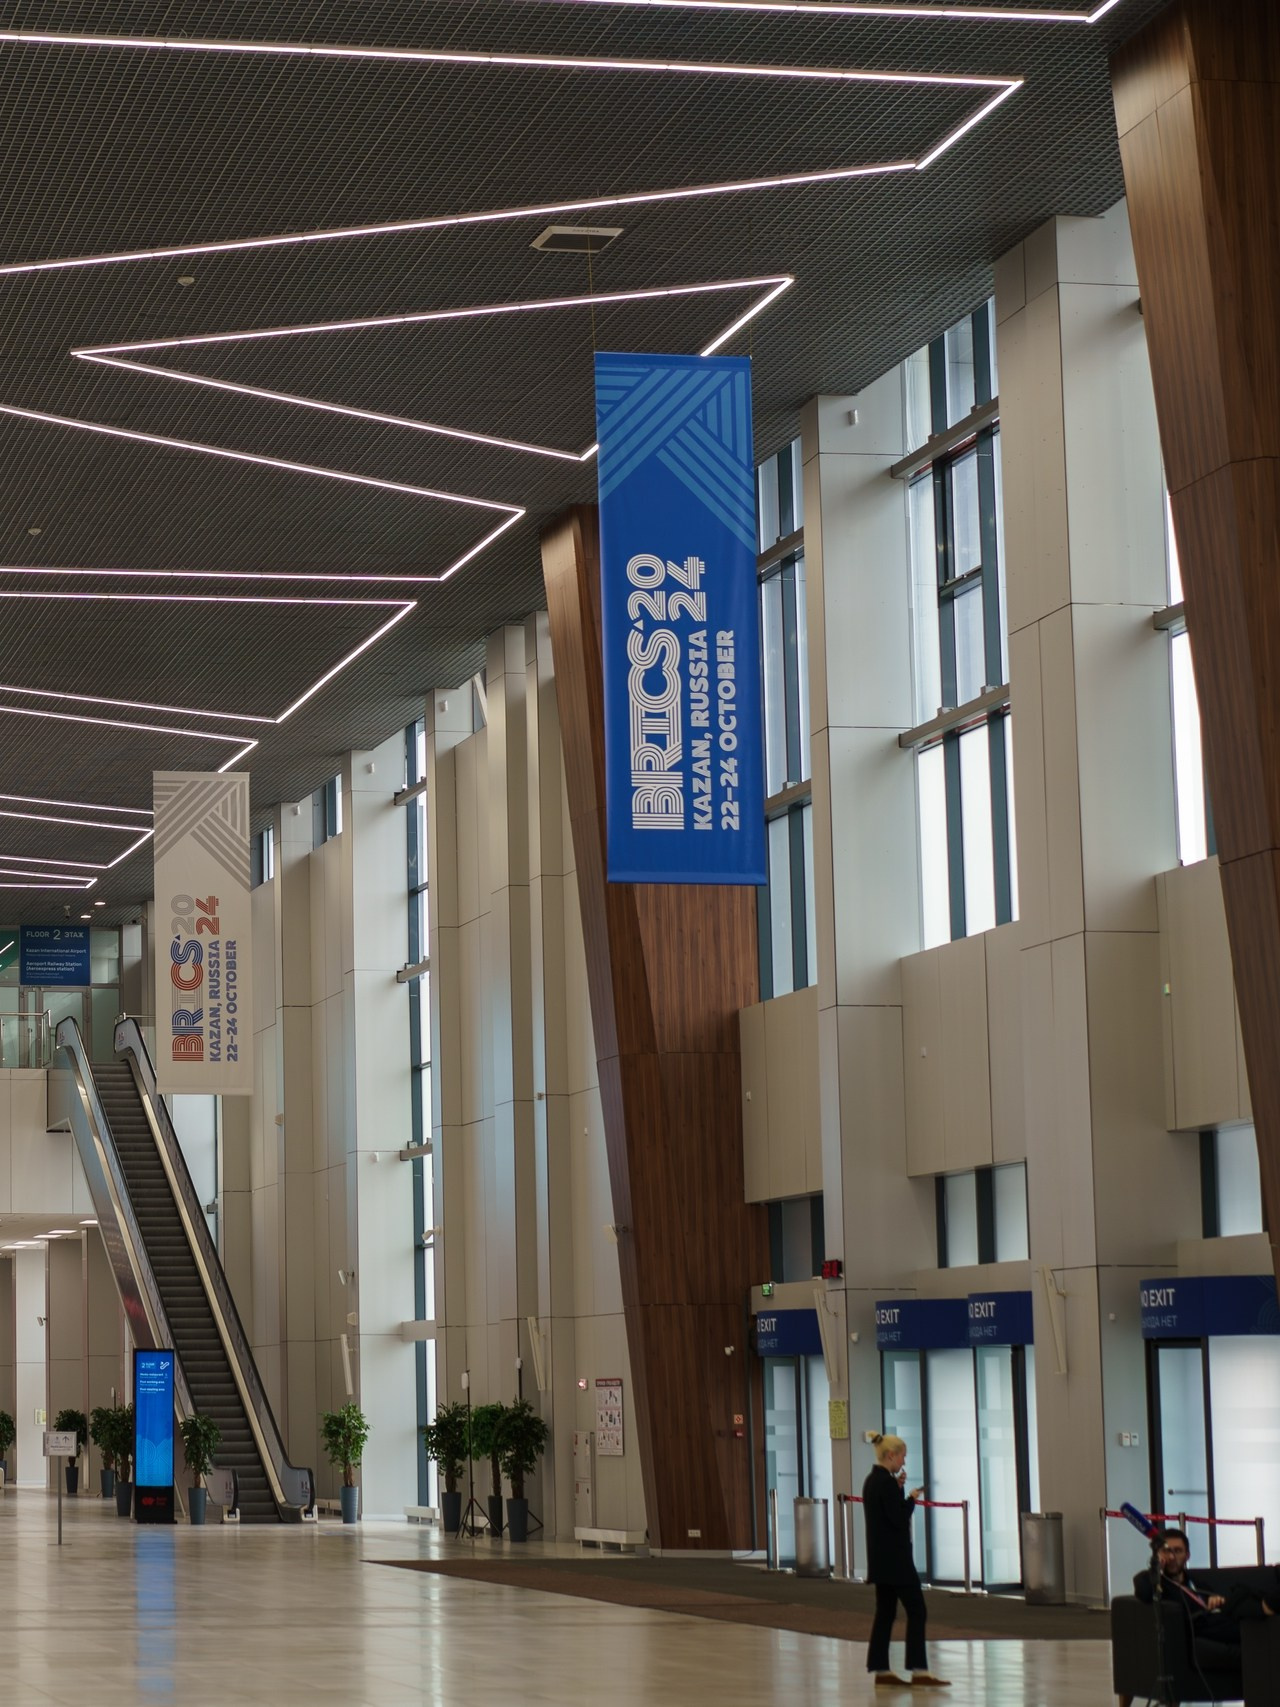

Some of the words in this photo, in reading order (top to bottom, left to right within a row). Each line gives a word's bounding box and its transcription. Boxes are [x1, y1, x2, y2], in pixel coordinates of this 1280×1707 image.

[666, 556, 706, 621] 24
[688, 629, 710, 727] RUSSIA
[716, 630, 737, 751] OCTOBER
[691, 734, 713, 830] KAZAN,
[720, 757, 740, 830] 22-24
[53, 929, 61, 940] 2
[208, 940, 220, 999] RUSSIA
[226, 940, 238, 1014] OCTOBER
[209, 1002, 223, 1062] KAZAN,
[761, 1318, 776, 1332] EXIT
[881, 1309, 900, 1324] EXIT
[974, 1302, 996, 1318] EXIT
[1149, 1288, 1176, 1307] EXIT
[1161, 1315, 1177, 1327] НЕТ
